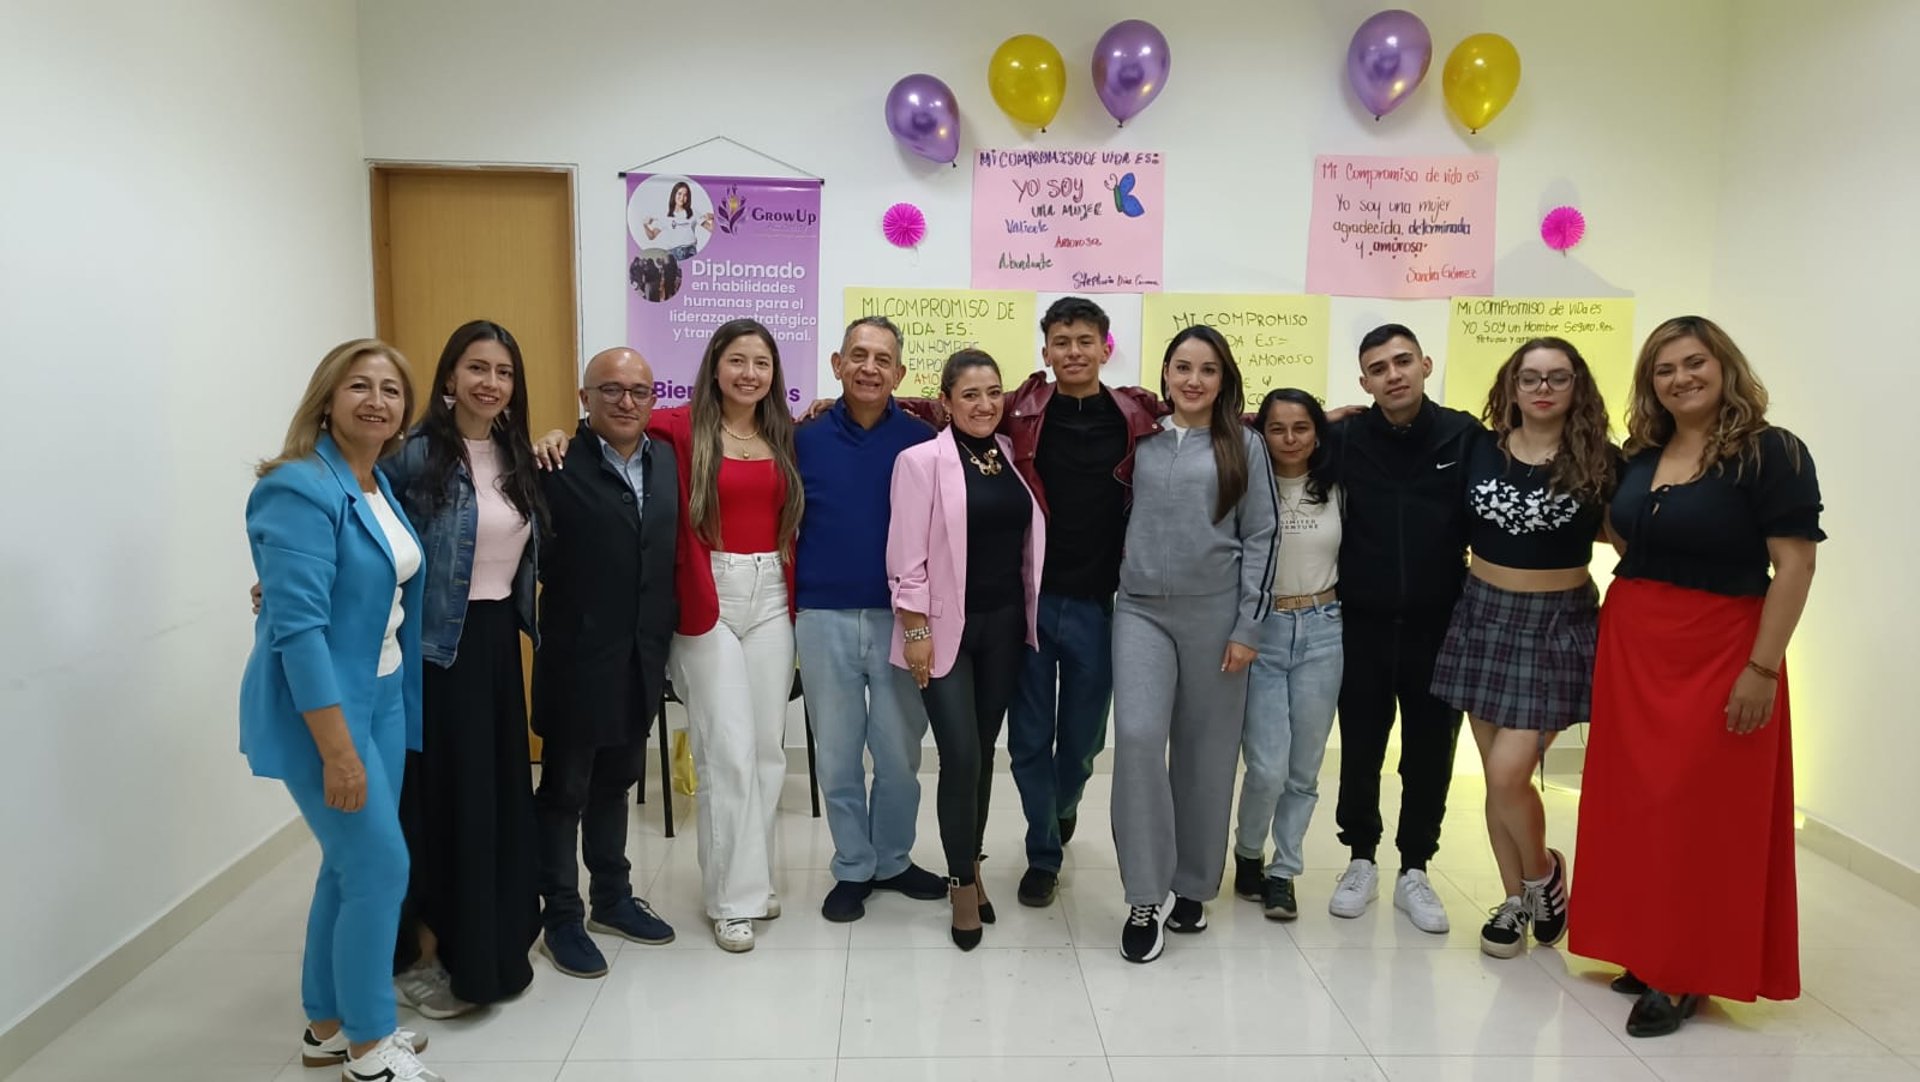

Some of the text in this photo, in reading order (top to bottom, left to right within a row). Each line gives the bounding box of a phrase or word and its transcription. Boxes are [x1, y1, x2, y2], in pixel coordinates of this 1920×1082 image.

[1346, 163, 1418, 190] Compromiso
[1425, 166, 1440, 183] de
[1444, 167, 1463, 185] vida
[1467, 172, 1479, 183] es
[1336, 194, 1451, 223] Yo soy una mujer
[1408, 216, 1471, 235] determinada
[691, 259, 806, 281] Diplomado
[1406, 266, 1439, 283] Sandra
[692, 281, 796, 293] en habilidades
[683, 295, 804, 311] humanas para el
[997, 301, 1016, 320] DE
[1550, 301, 1565, 316] de
[670, 310, 734, 326] liderazgo
[1203, 312, 1308, 328] COMPROMISO
[672, 328, 682, 341] y
[946, 322, 974, 336] ES:
[908, 340, 925, 354] UN
[1249, 353, 1313, 366] AMOROSO
